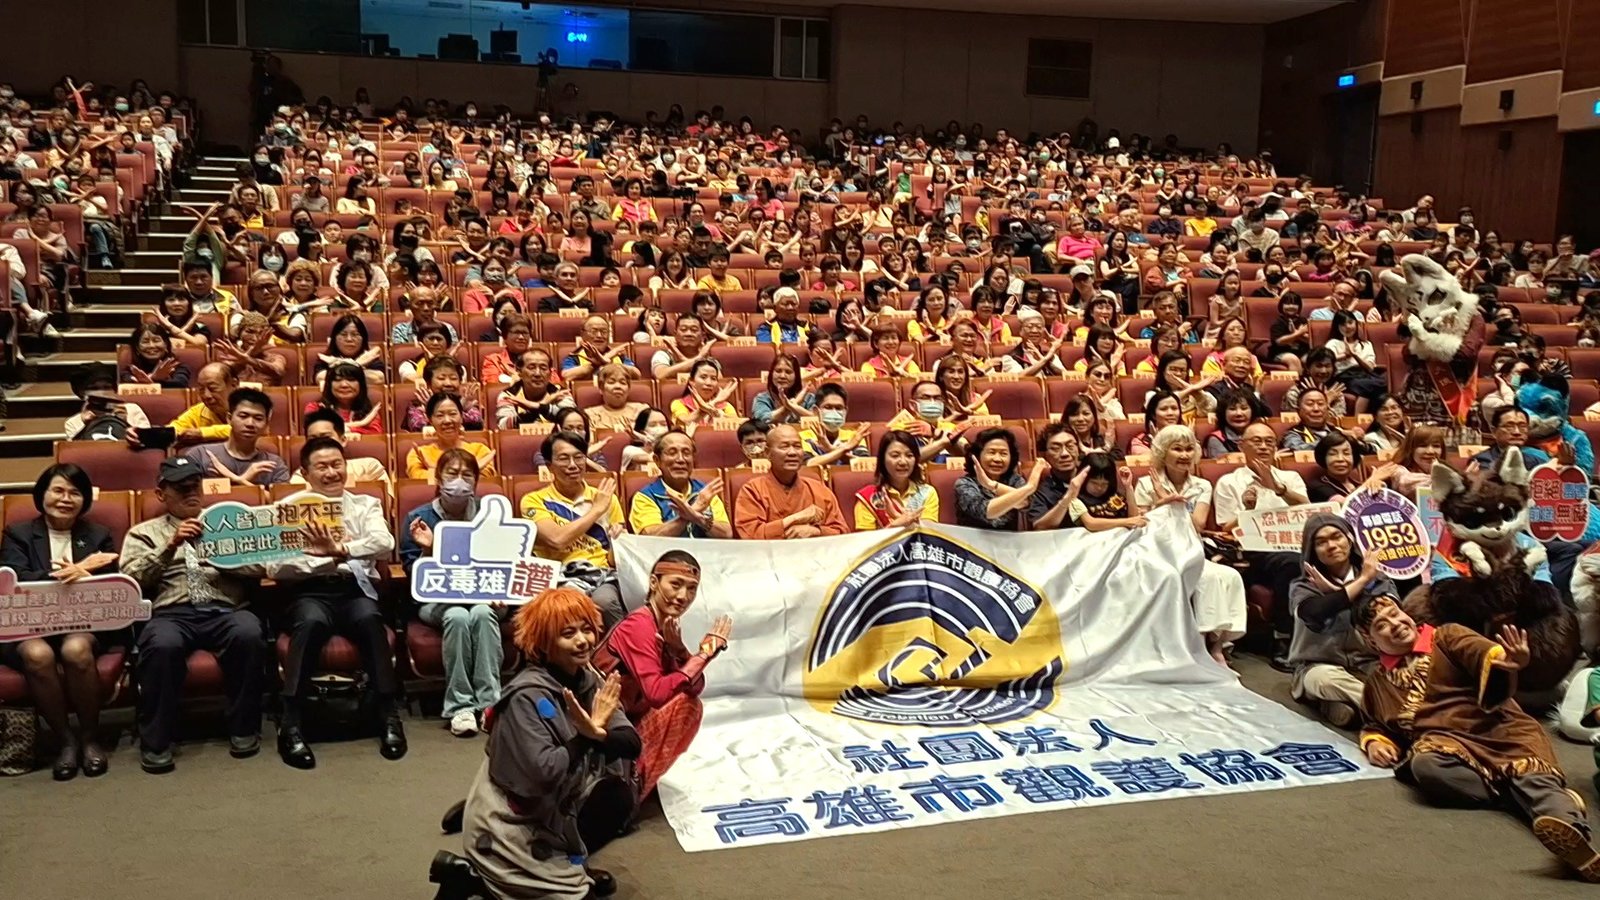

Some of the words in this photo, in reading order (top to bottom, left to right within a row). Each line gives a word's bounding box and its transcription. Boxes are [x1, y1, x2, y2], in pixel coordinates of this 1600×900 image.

[1362, 523, 1418, 550] 1953
[847, 541, 1036, 614] 社團法人高雄市觀護協會
[842, 718, 1157, 774] 社團法人
[702, 740, 1362, 844] 高雄市觀護協會
